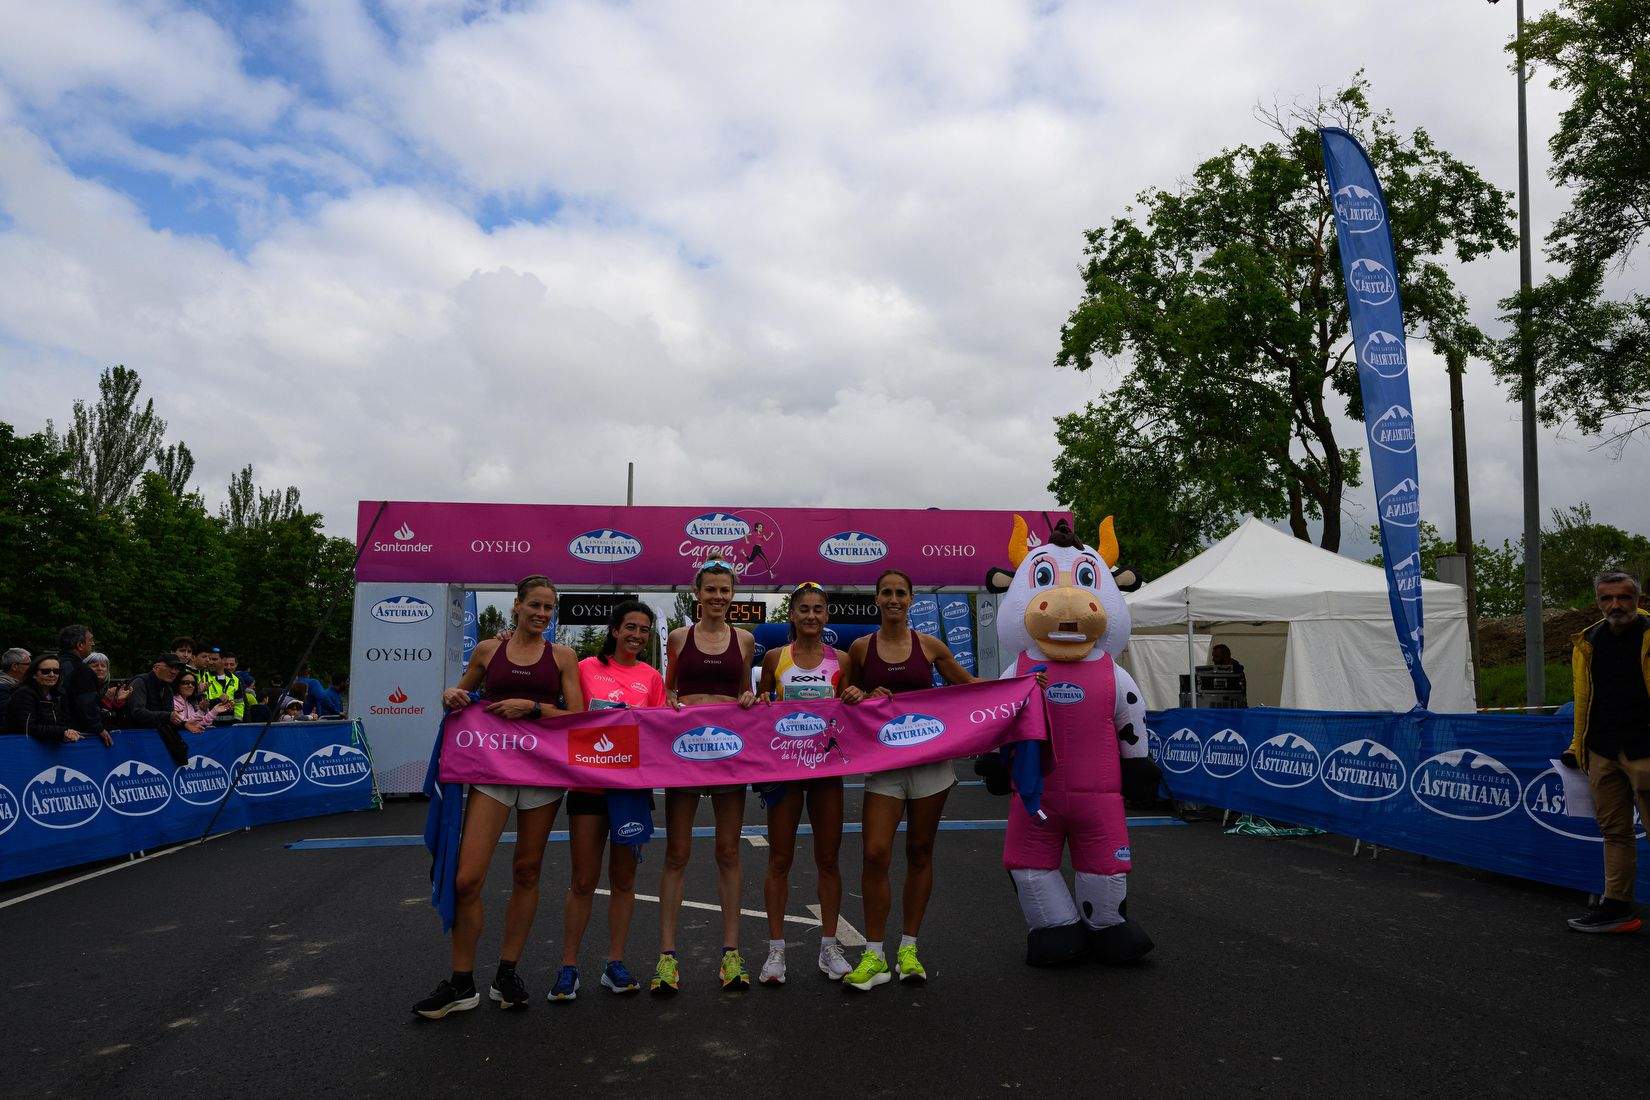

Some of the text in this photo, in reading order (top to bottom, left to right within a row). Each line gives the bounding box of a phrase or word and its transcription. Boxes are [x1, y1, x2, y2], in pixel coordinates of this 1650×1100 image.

[690, 523, 746, 535] ASTURIANA
[374, 541, 433, 553] Santander
[471, 540, 531, 553] OYSHO
[574, 541, 637, 554] ASTURIANA
[679, 540, 734, 557] Carrera
[824, 543, 883, 556] ASTURIANA
[922, 544, 976, 557] OYSHO
[376, 606, 429, 617] ASTURIANA
[572, 604, 614, 616] OYSH
[828, 603, 878, 616] OYSHO
[366, 648, 432, 661] OYSHO
[370, 705, 425, 715] Santander
[779, 722, 824, 732] ASTURIANA
[883, 725, 941, 742] ASTURIANA
[456, 730, 538, 751] OYSHO
[678, 740, 739, 753] ASTURIANA
[770, 736, 815, 750] Carrera
[575, 754, 633, 764] Santander
[781, 747, 831, 769] de la Mujer
[1164, 744, 1199, 762] ASTURIANA
[1204, 746, 1244, 766] ASTURIANA
[1255, 750, 1313, 777] ASTURIANA
[1325, 758, 1398, 790] ASTURIANA
[1435, 769, 1511, 785] CENTRAL LECHERA
[179, 776, 227, 795] ASTURIANA
[1416, 769, 1511, 807] ASTURIANA
[110, 783, 168, 805] ASTURIANA
[31, 790, 99, 816] ASTURIANA
